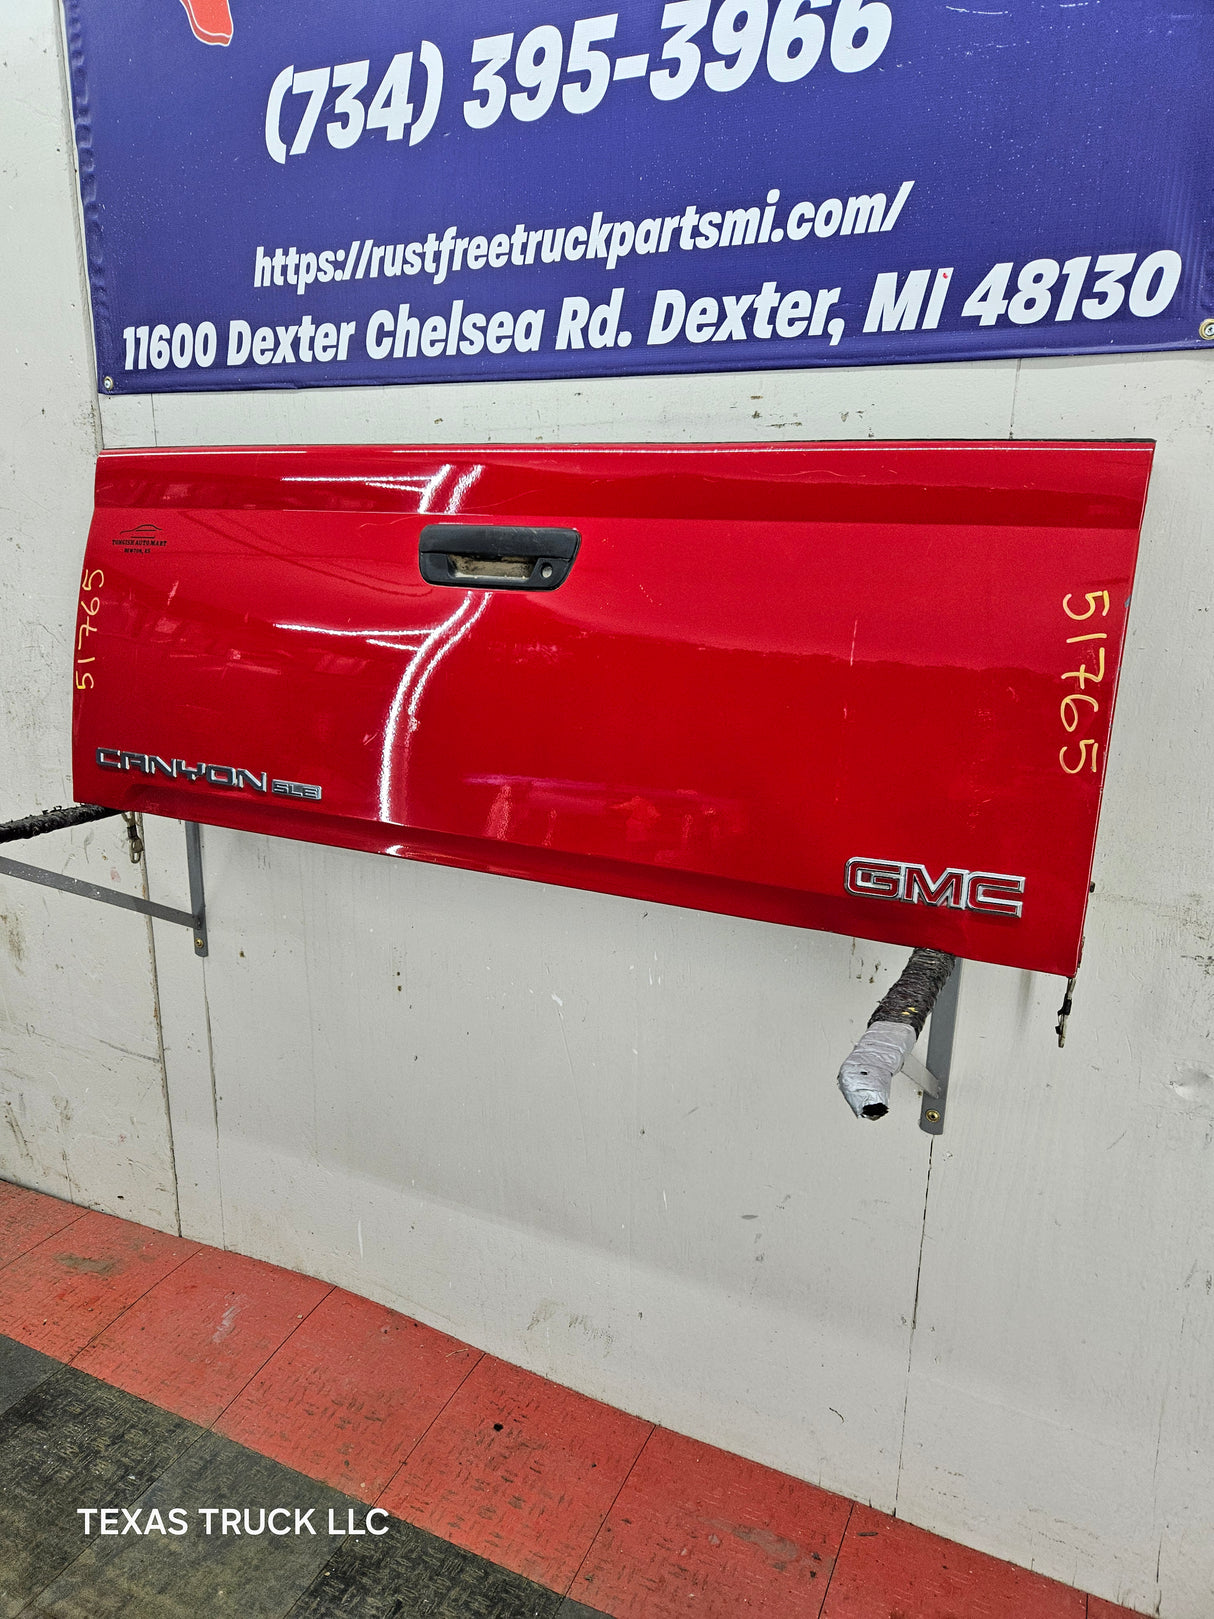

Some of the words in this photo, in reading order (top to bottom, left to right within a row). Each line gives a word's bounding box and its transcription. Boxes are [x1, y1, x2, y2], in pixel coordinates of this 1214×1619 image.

[265, 40, 444, 164] (734)
[464, 0, 893, 130] 395-3966
[254, 181, 915, 295] https://rustfreetruckpartsmi.com/
[123, 321, 217, 370] 11600
[227, 313, 356, 366] Dexter
[366, 300, 545, 360] Chelsea
[555, 288, 633, 351] Rd.
[647, 281, 846, 346] Dexter,
[863, 267, 954, 332] MI
[961, 249, 1182, 326] 48130
[76, 569, 104, 690] 51765
[1059, 590, 1110, 774] 51765
[96, 747, 268, 793] CANYON
[272, 779, 322, 800] SLE
[844, 856, 1026, 918] GMC
